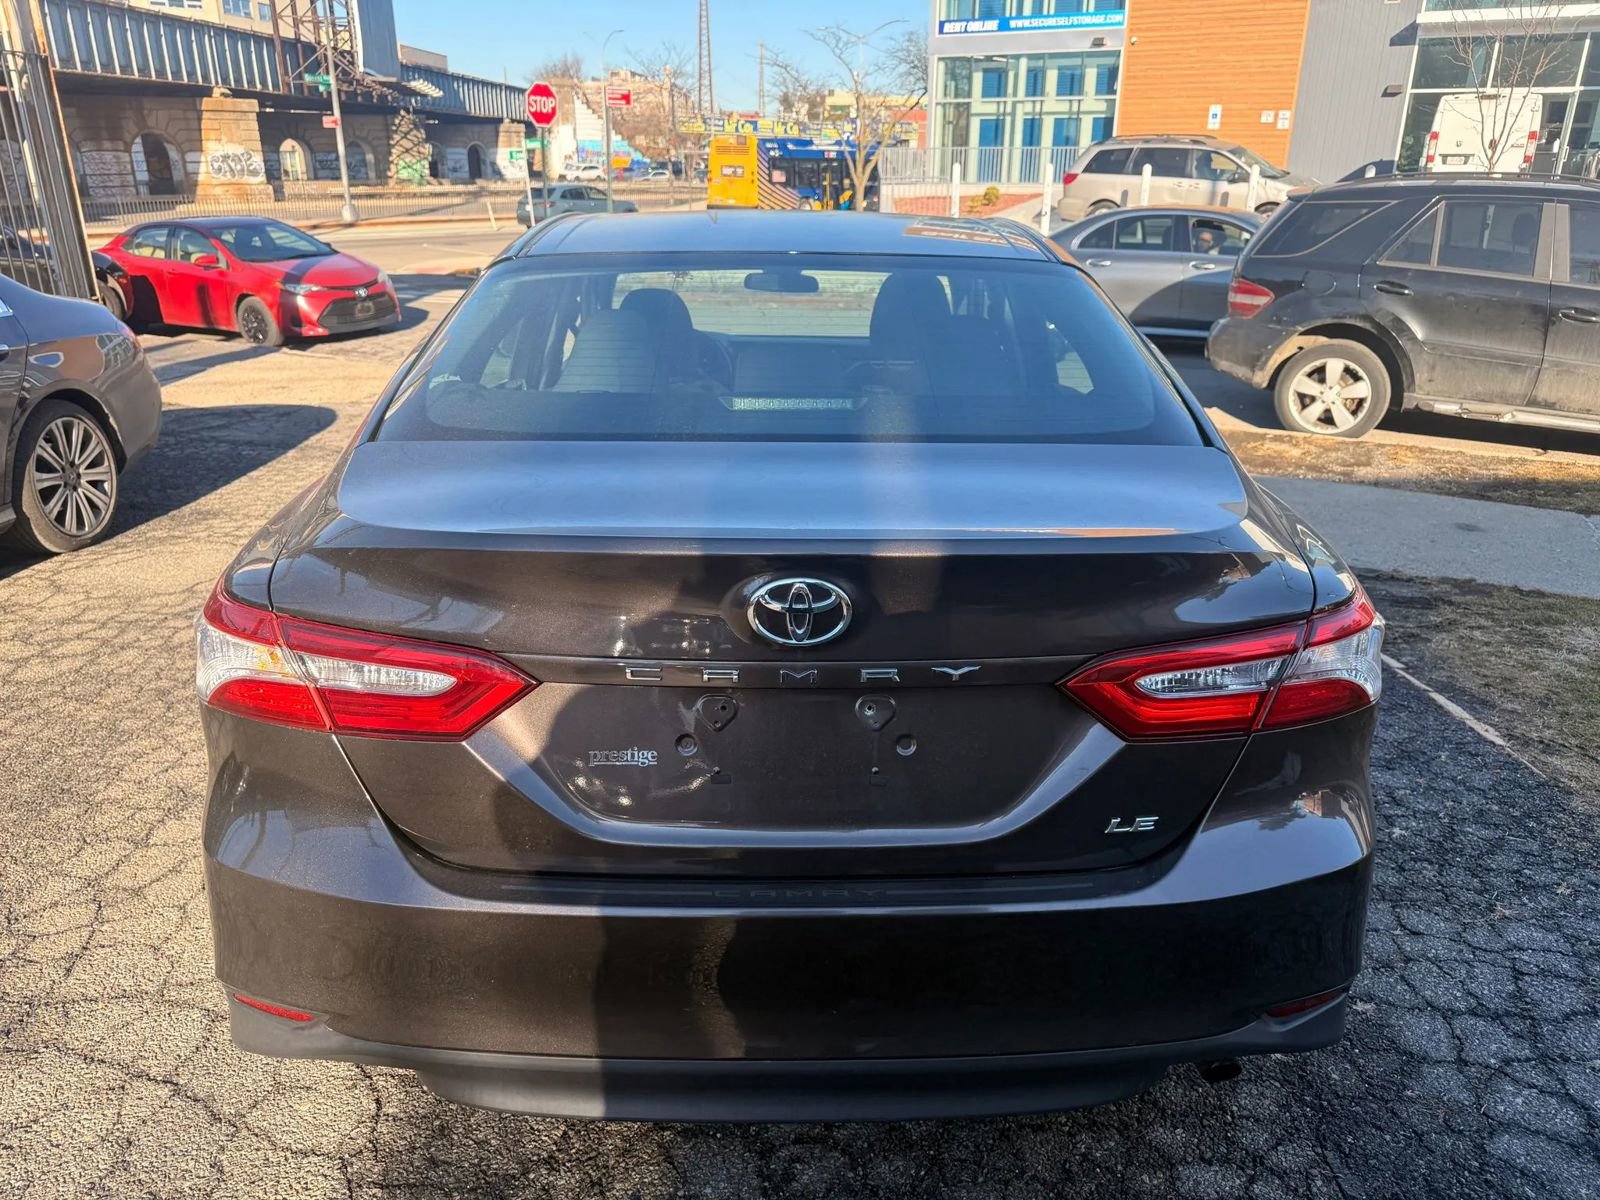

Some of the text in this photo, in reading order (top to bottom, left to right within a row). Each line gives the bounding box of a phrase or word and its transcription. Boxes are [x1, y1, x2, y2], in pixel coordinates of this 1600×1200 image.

[943, 21, 967, 33] RENT
[967, 20, 999, 32] ONLINE
[529, 95, 556, 113] STOP
[625, 665, 981, 683] CAMRY
[588, 746, 658, 767] prestige
[1104, 816, 1159, 833] LE
[714, 888, 881, 898] CAMRY
